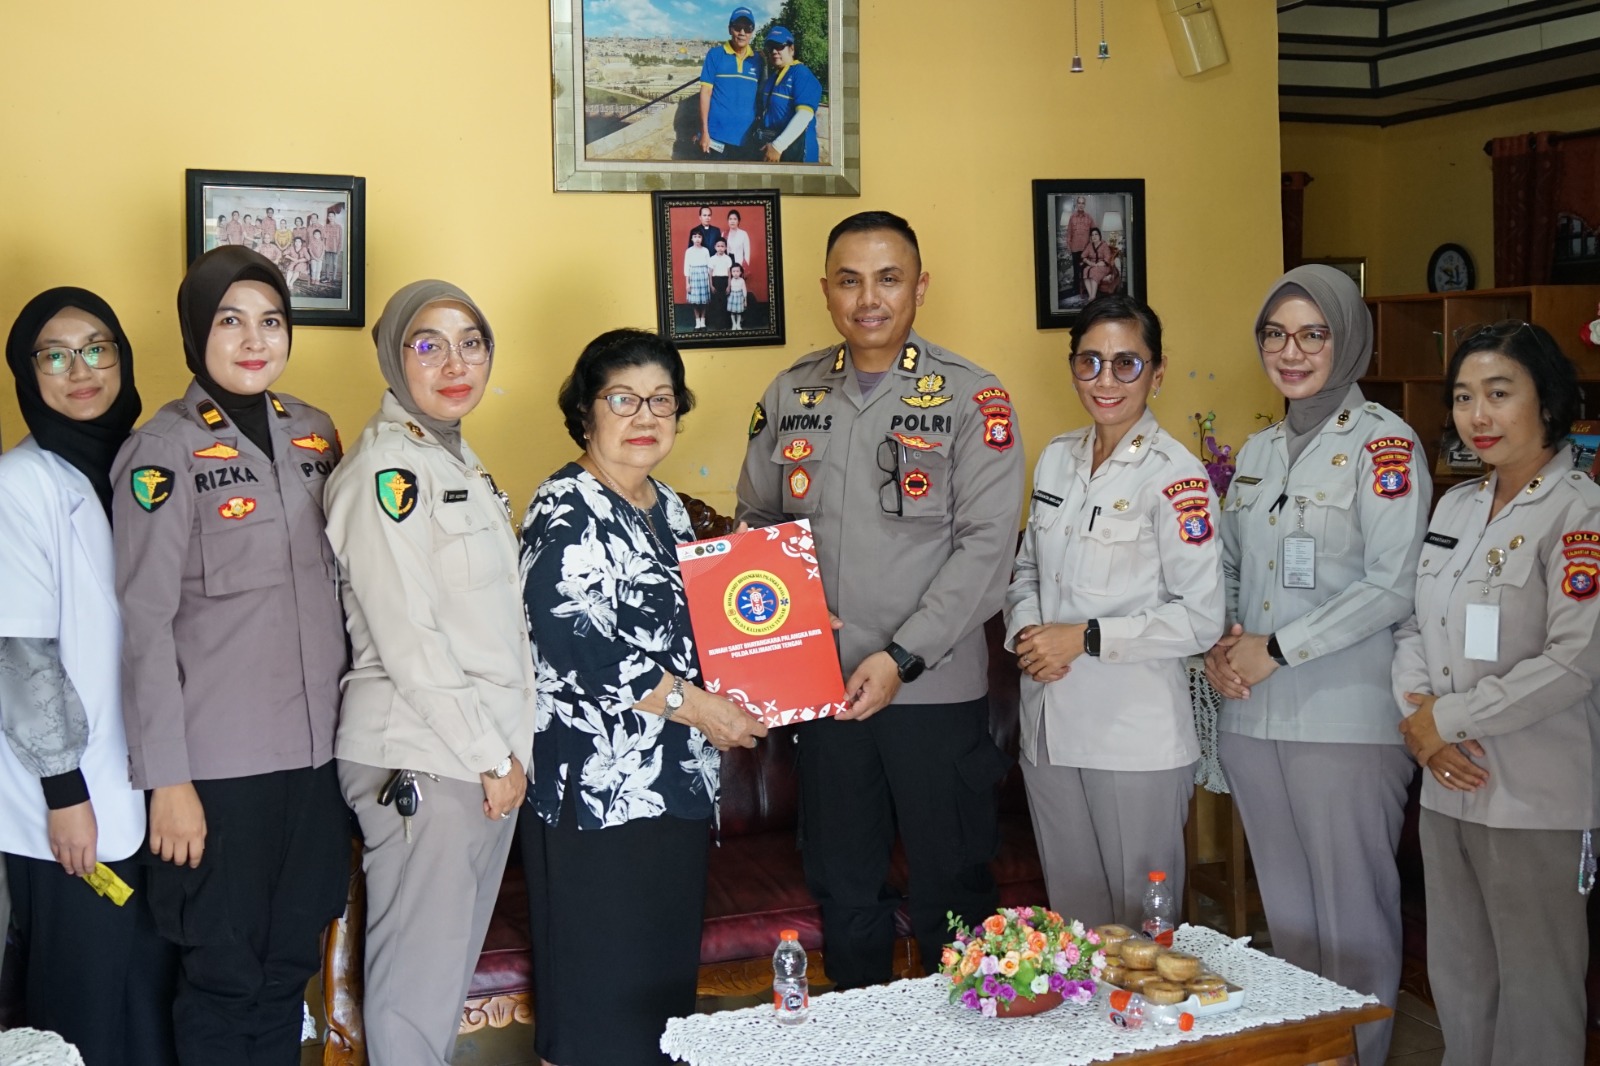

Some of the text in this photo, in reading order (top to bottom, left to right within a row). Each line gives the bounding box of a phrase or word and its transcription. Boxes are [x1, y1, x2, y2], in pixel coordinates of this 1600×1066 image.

[977, 389, 1007, 402] POLDA
[780, 414, 832, 432] ANTON.S
[890, 414, 952, 432] POLRI
[1370, 439, 1409, 450] POLDA
[300, 460, 333, 478] POL
[195, 466, 259, 493] RIZKA
[1167, 480, 1205, 496] POLDA
[1566, 534, 1600, 544] POLD
